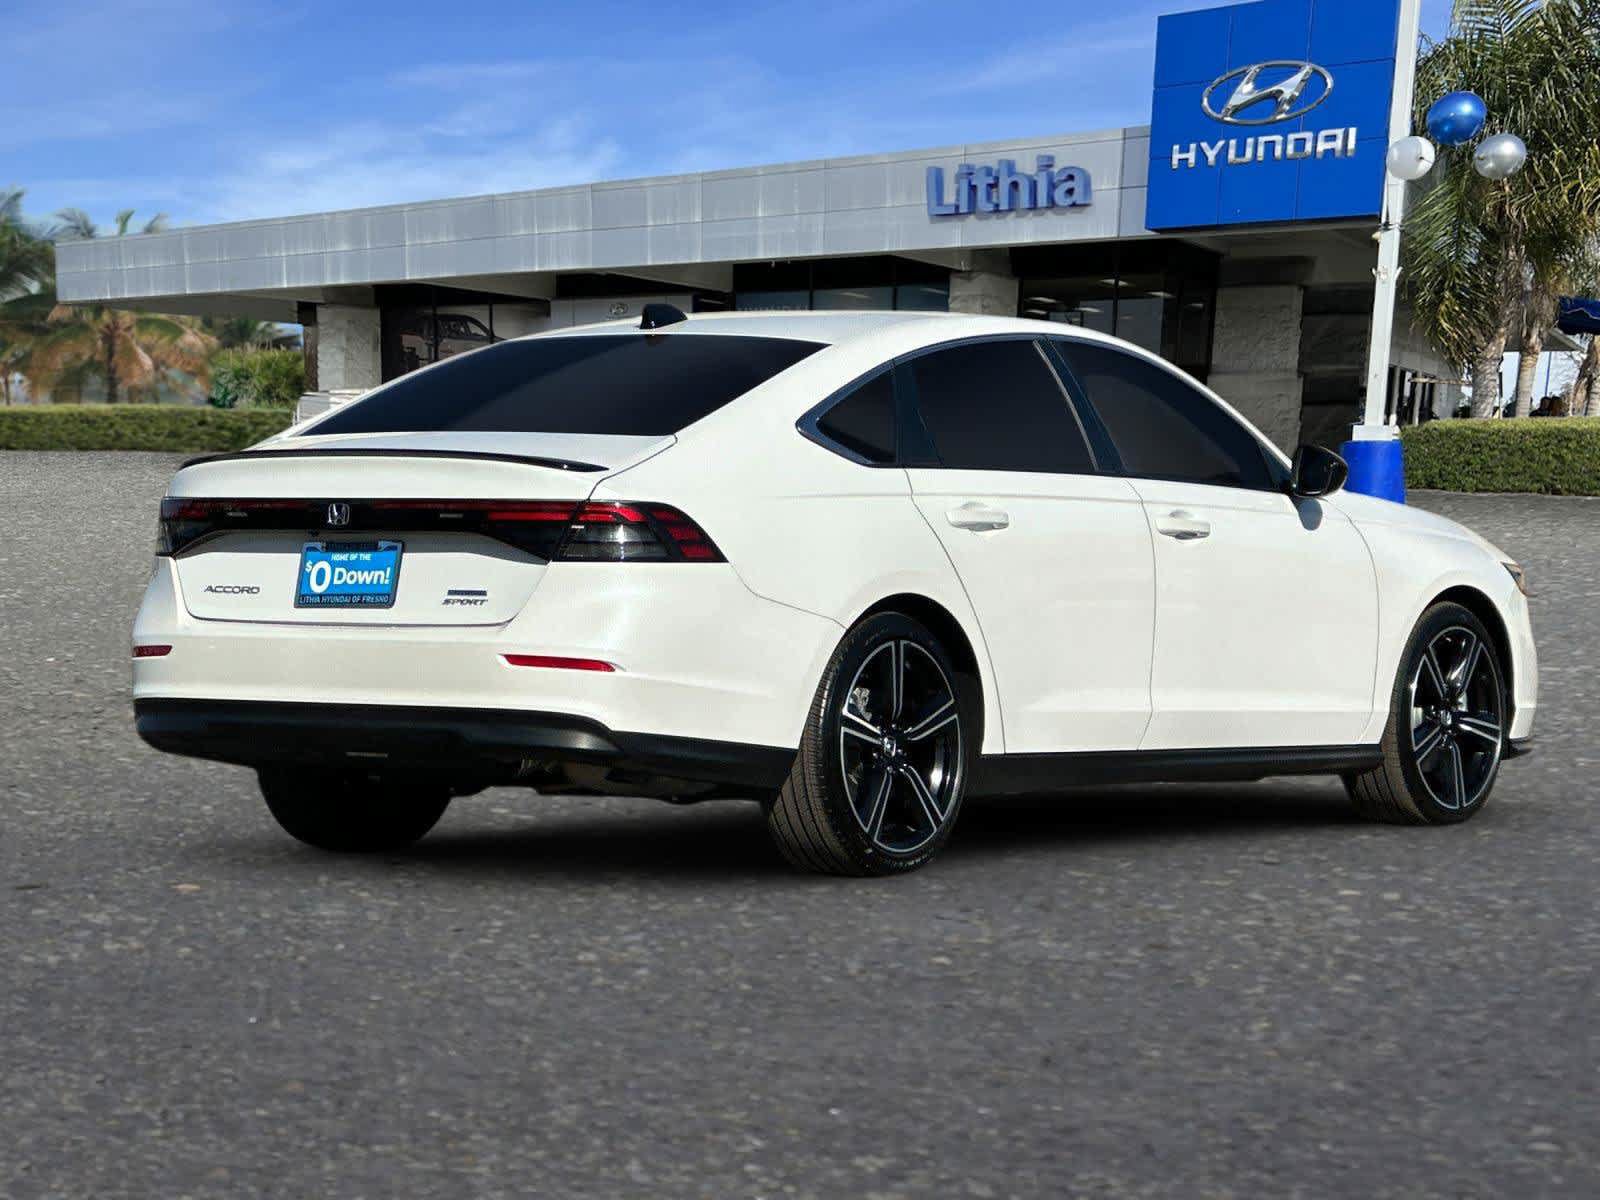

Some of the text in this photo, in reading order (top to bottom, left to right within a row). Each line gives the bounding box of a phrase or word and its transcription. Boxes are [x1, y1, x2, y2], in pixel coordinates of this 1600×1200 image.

[1171, 126, 1358, 169] HYUNDAI
[925, 154, 1093, 217] Lithia
[331, 553, 372, 561] HOME OF THE
[333, 567, 391, 585] Down!
[203, 585, 261, 594] ACCORD
[299, 595, 389, 604] LITHIA HYUNDAI OF FRESNO
[441, 598, 489, 606] SPORT
